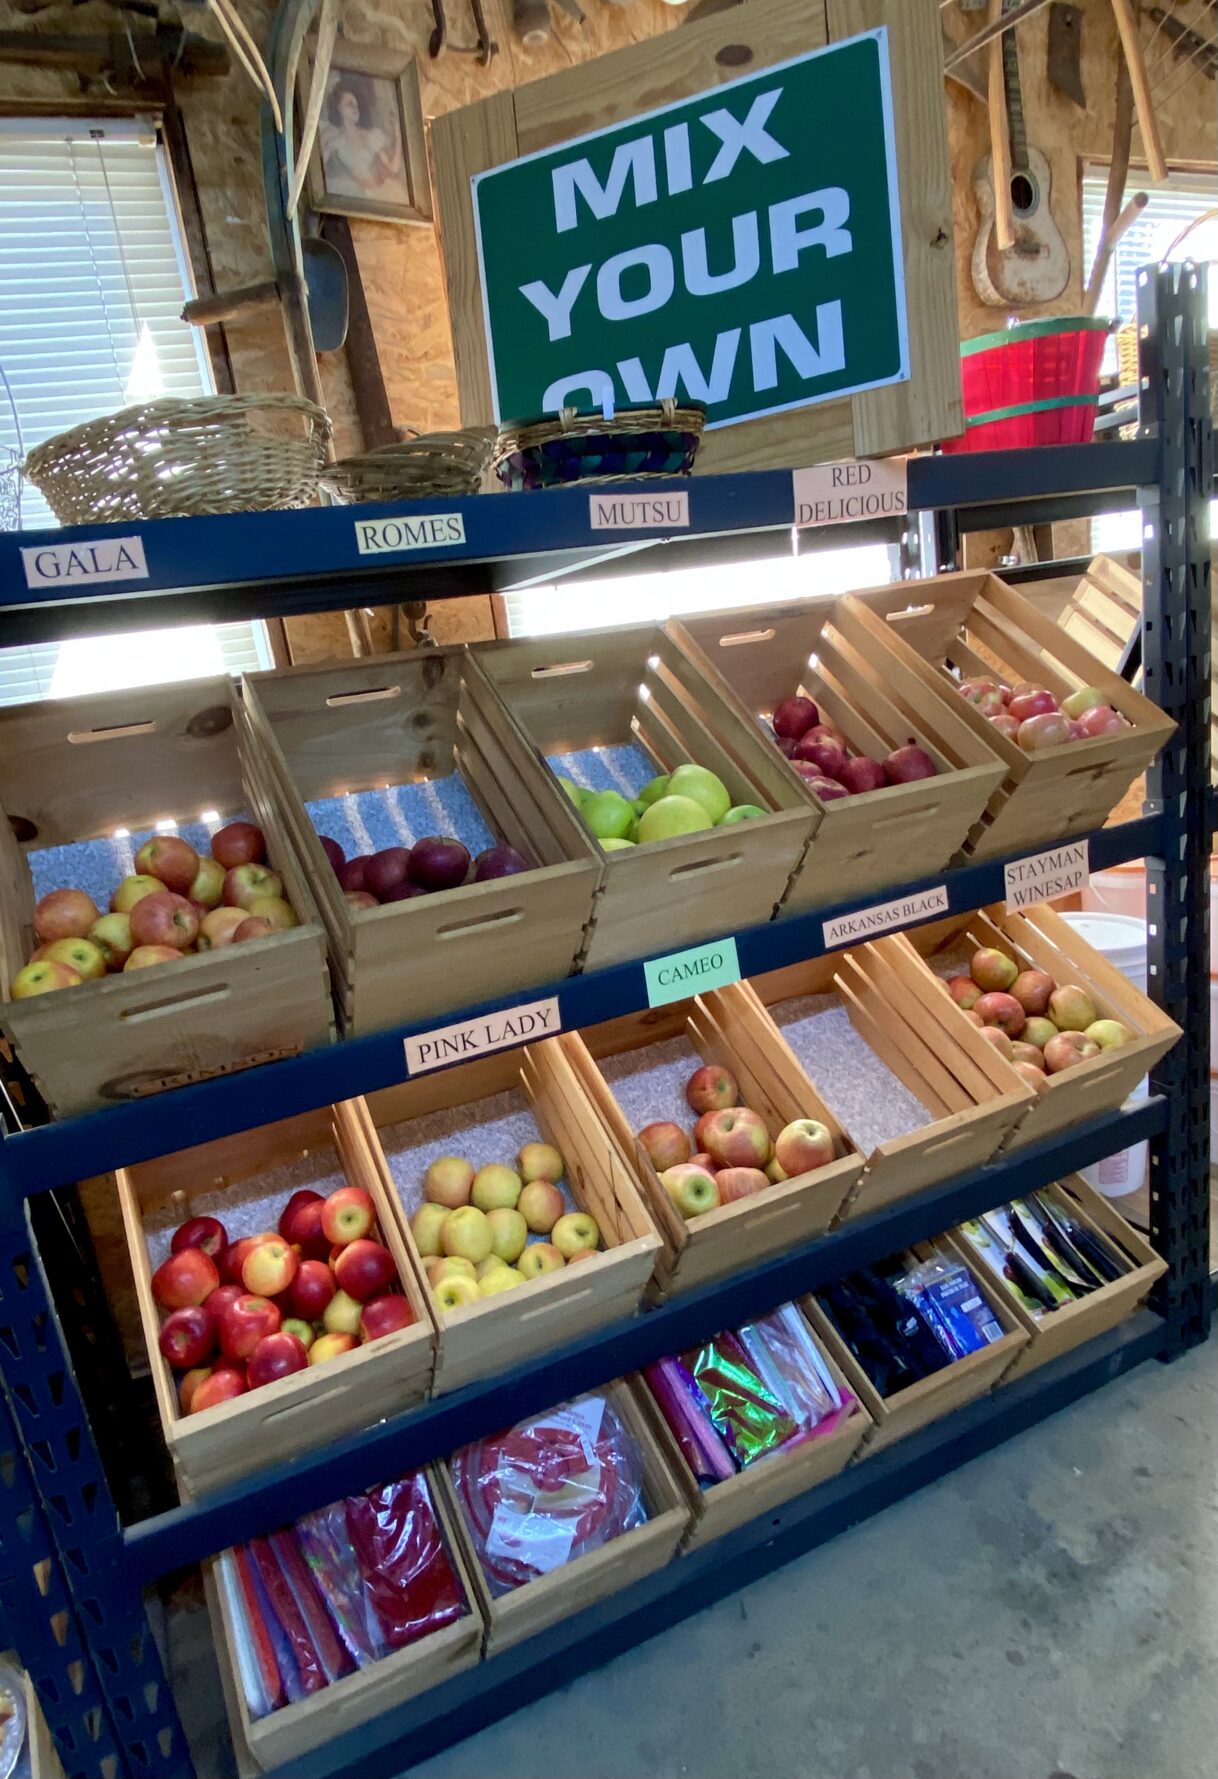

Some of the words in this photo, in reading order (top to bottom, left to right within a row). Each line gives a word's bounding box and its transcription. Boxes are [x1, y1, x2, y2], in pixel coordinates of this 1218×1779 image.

[552, 87, 790, 233] MIX
[518, 186, 853, 341] YOUR
[832, 464, 871, 487] RED
[598, 500, 682, 525] MUTSU
[800, 491, 905, 524] DELICIOUS
[362, 517, 463, 550] ROMES
[35, 544, 140, 579] GALA
[1007, 846, 1085, 885] STAYMAN
[1013, 871, 1083, 906] WINESAP
[829, 908, 900, 940] ARKANSAS
[903, 893, 946, 917] BLACK
[658, 953, 724, 986] CAMEO
[417, 1030, 479, 1064] PINK
[484, 1008, 552, 1044] LADY
